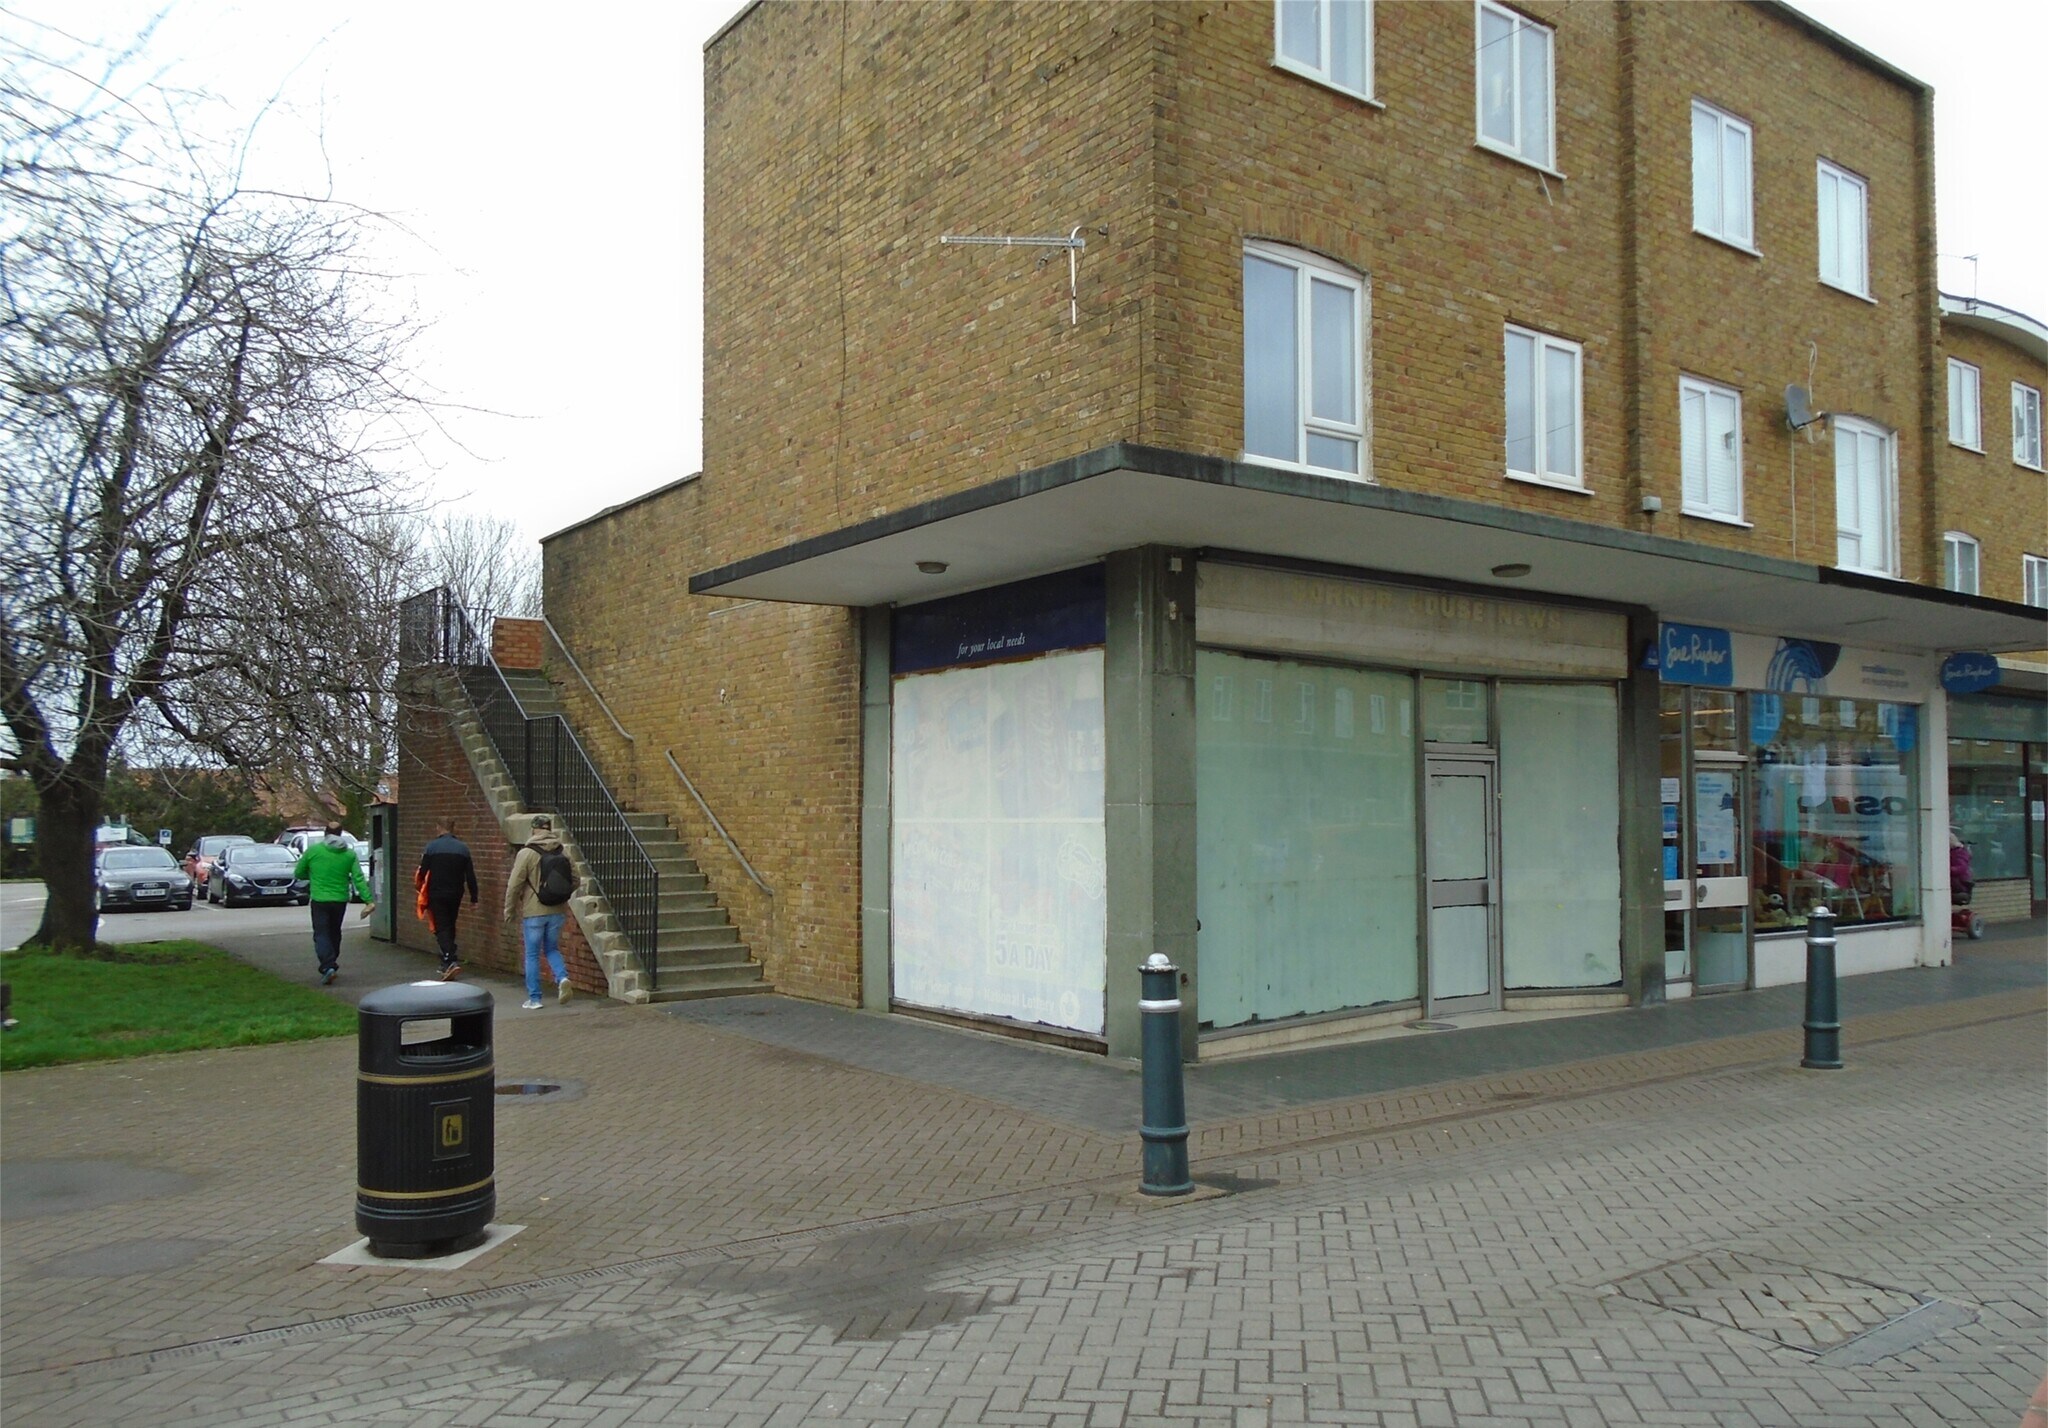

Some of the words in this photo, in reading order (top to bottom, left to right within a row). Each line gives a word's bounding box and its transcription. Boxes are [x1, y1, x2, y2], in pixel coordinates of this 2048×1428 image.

[956, 643, 968, 659] for
[968, 641, 985, 657] your
[987, 635, 1004, 651] local
[1006, 632, 1026, 647] needs
[1666, 627, 1691, 669] Sue
[1691, 633, 1727, 676] Ryder
[994, 934, 1008, 967] 5
[1009, 943, 1020, 967] A
[1024, 944, 1054, 972] DAY
[1022, 993, 1055, 1012] Lottery
